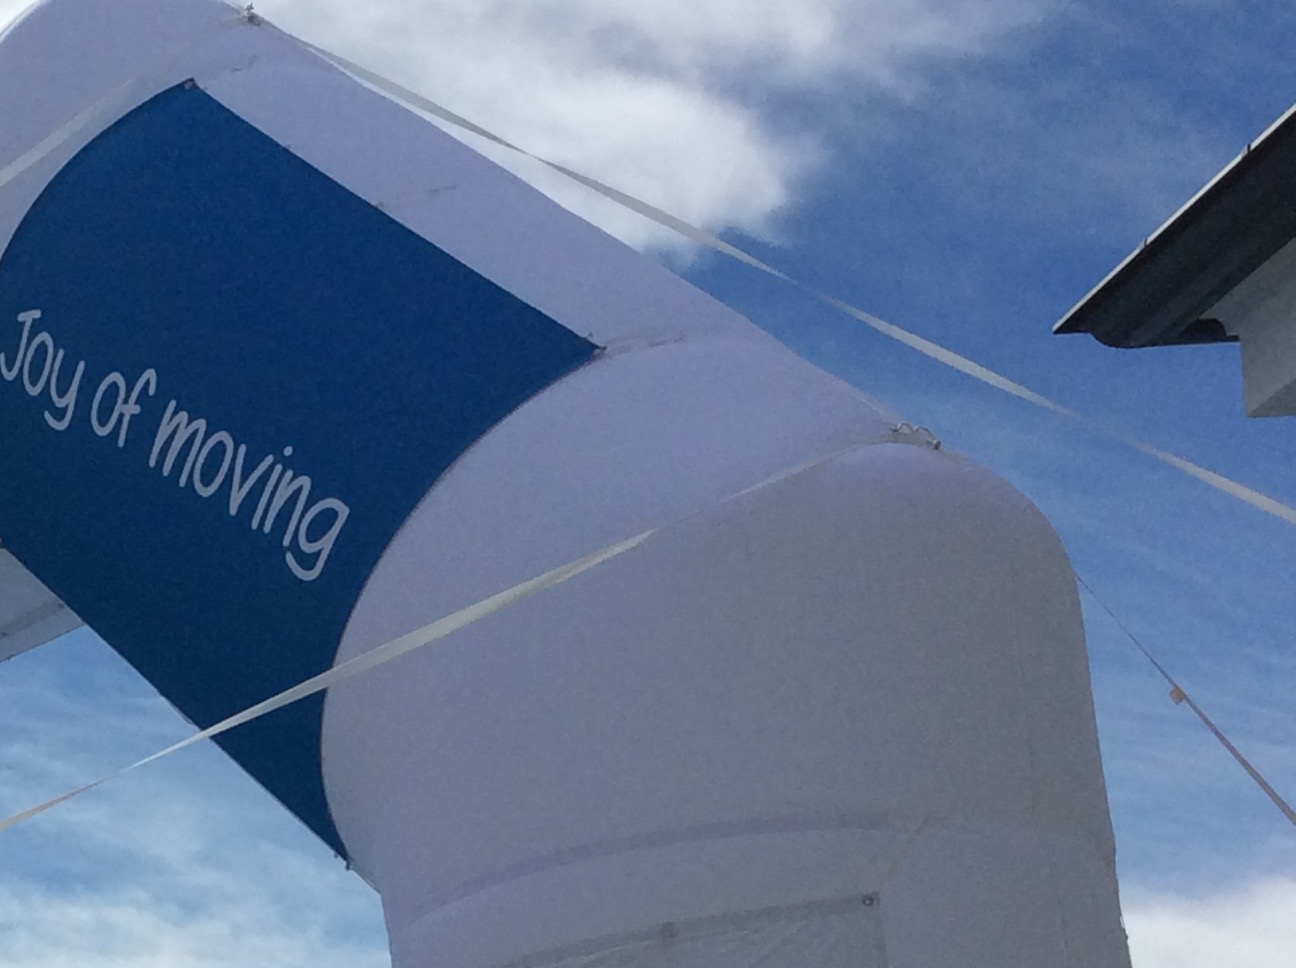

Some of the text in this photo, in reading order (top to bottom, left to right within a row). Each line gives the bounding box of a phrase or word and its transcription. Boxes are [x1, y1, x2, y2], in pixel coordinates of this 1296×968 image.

[0, 310, 350, 581] Joy of moving
